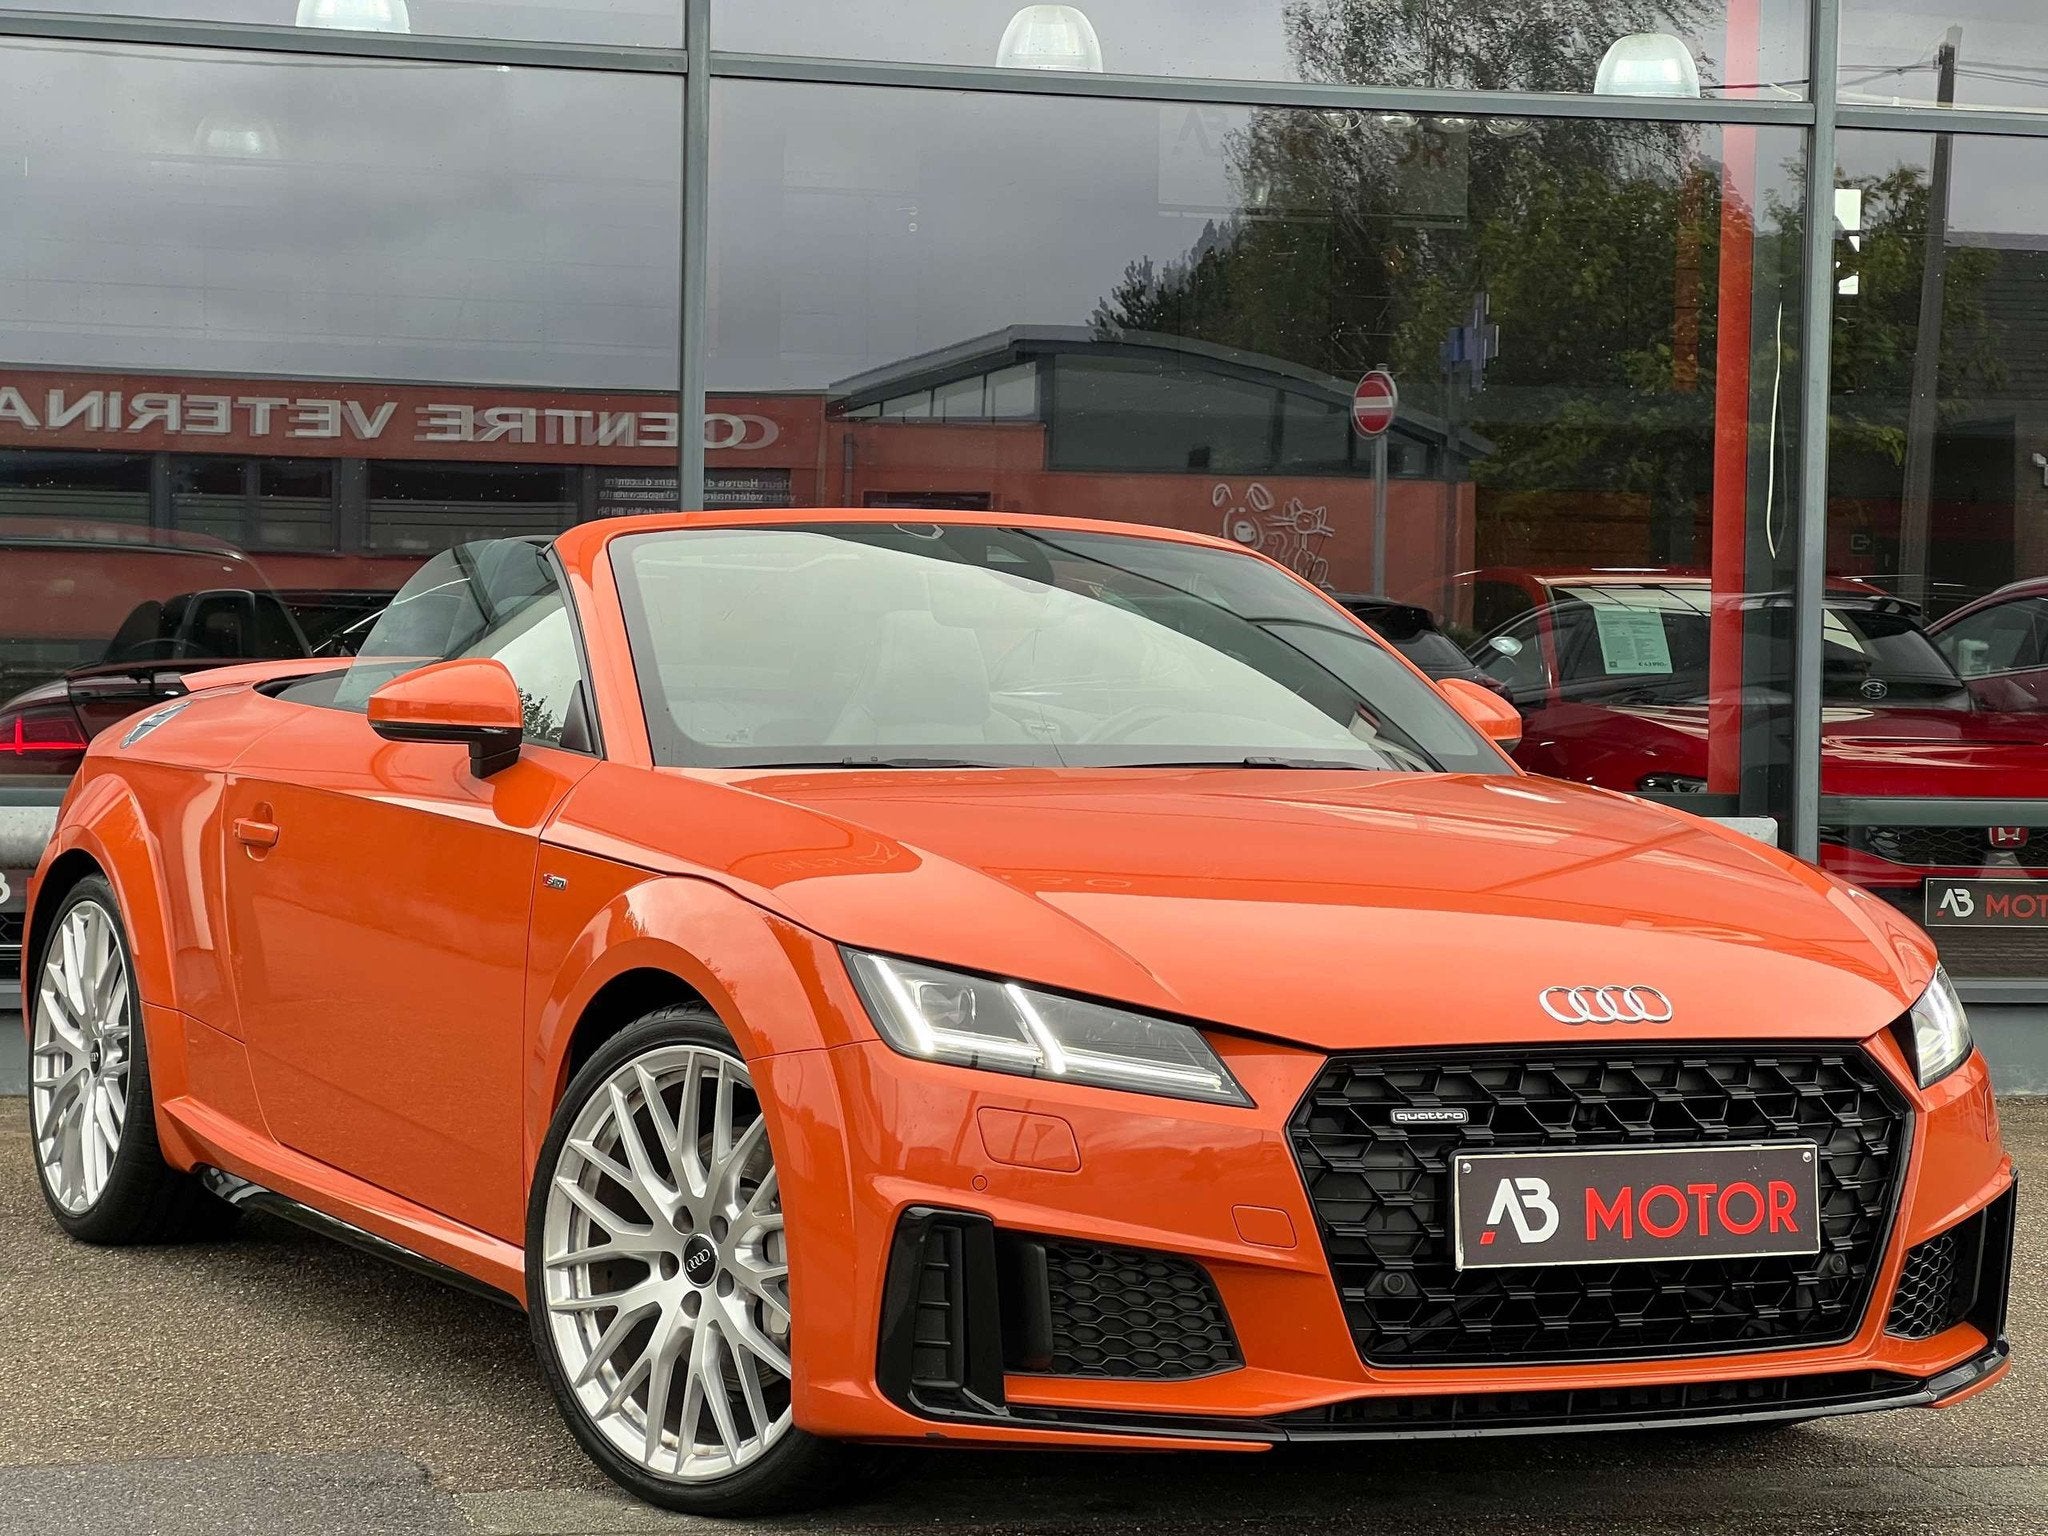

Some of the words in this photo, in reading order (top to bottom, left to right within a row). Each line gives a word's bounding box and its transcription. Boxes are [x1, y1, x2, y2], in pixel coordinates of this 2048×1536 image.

[1936, 888, 1975, 918] AB
[1396, 1112, 1464, 1121] quattro
[1480, 1177, 1560, 1244] AB
[1585, 1180, 1799, 1241] MOTOR
